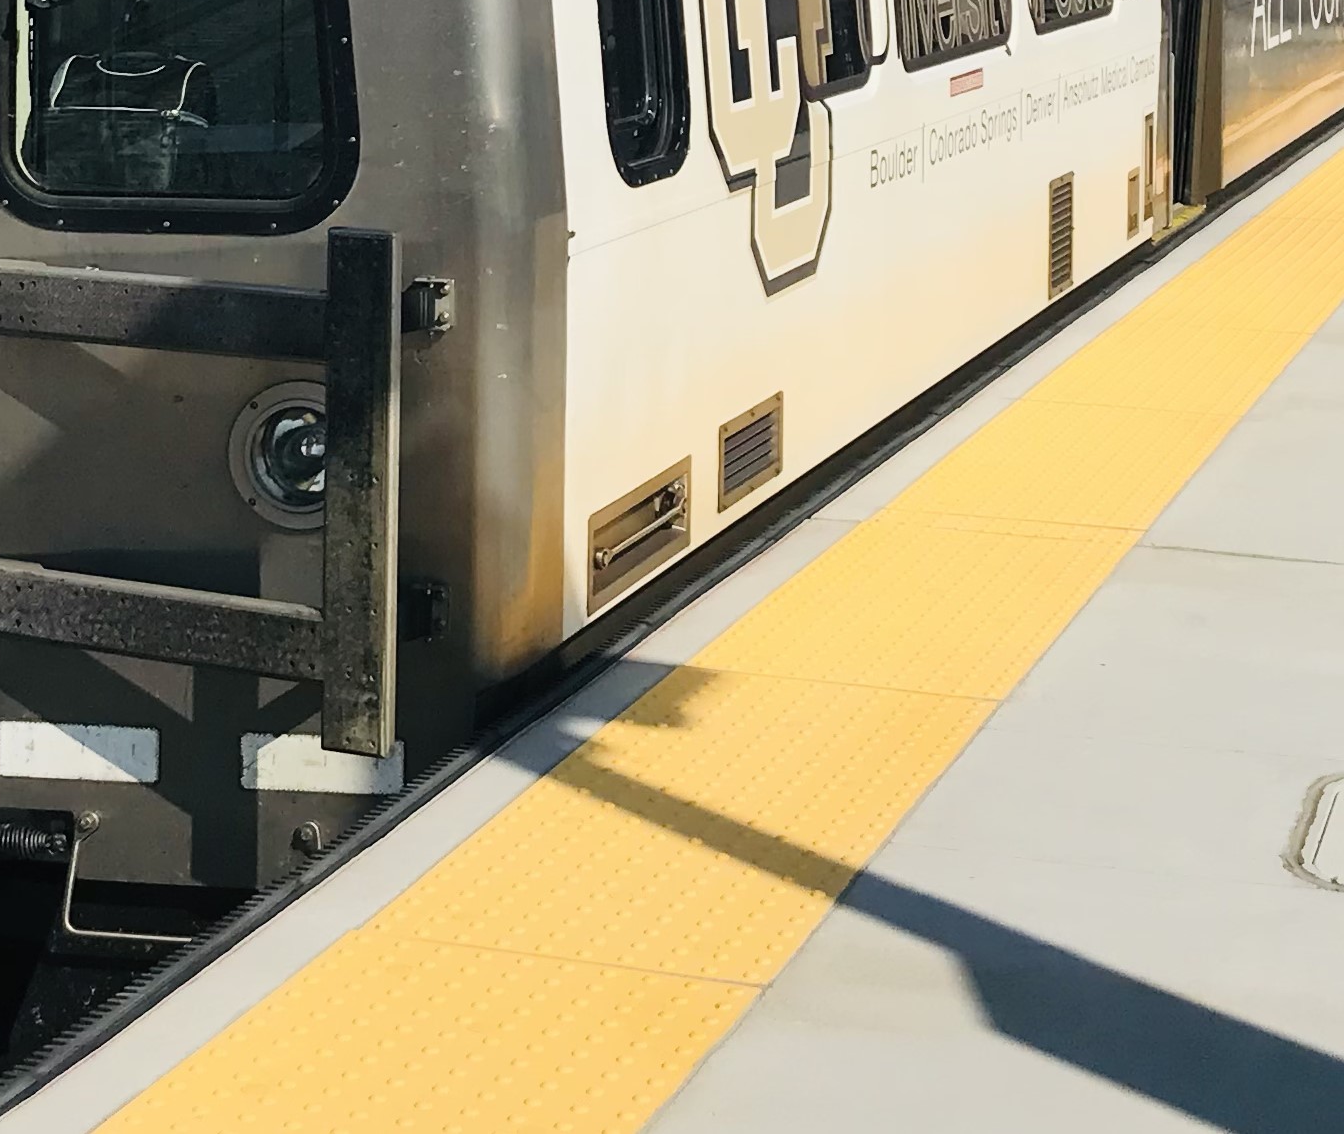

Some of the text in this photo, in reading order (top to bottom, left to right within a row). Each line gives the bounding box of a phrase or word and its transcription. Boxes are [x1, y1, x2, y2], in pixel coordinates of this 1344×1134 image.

[871, 140, 918, 188] Boulder
[929, 119, 978, 166] Colorado
[981, 105, 1018, 151] Springs
[1026, 91, 1057, 125] Denver
